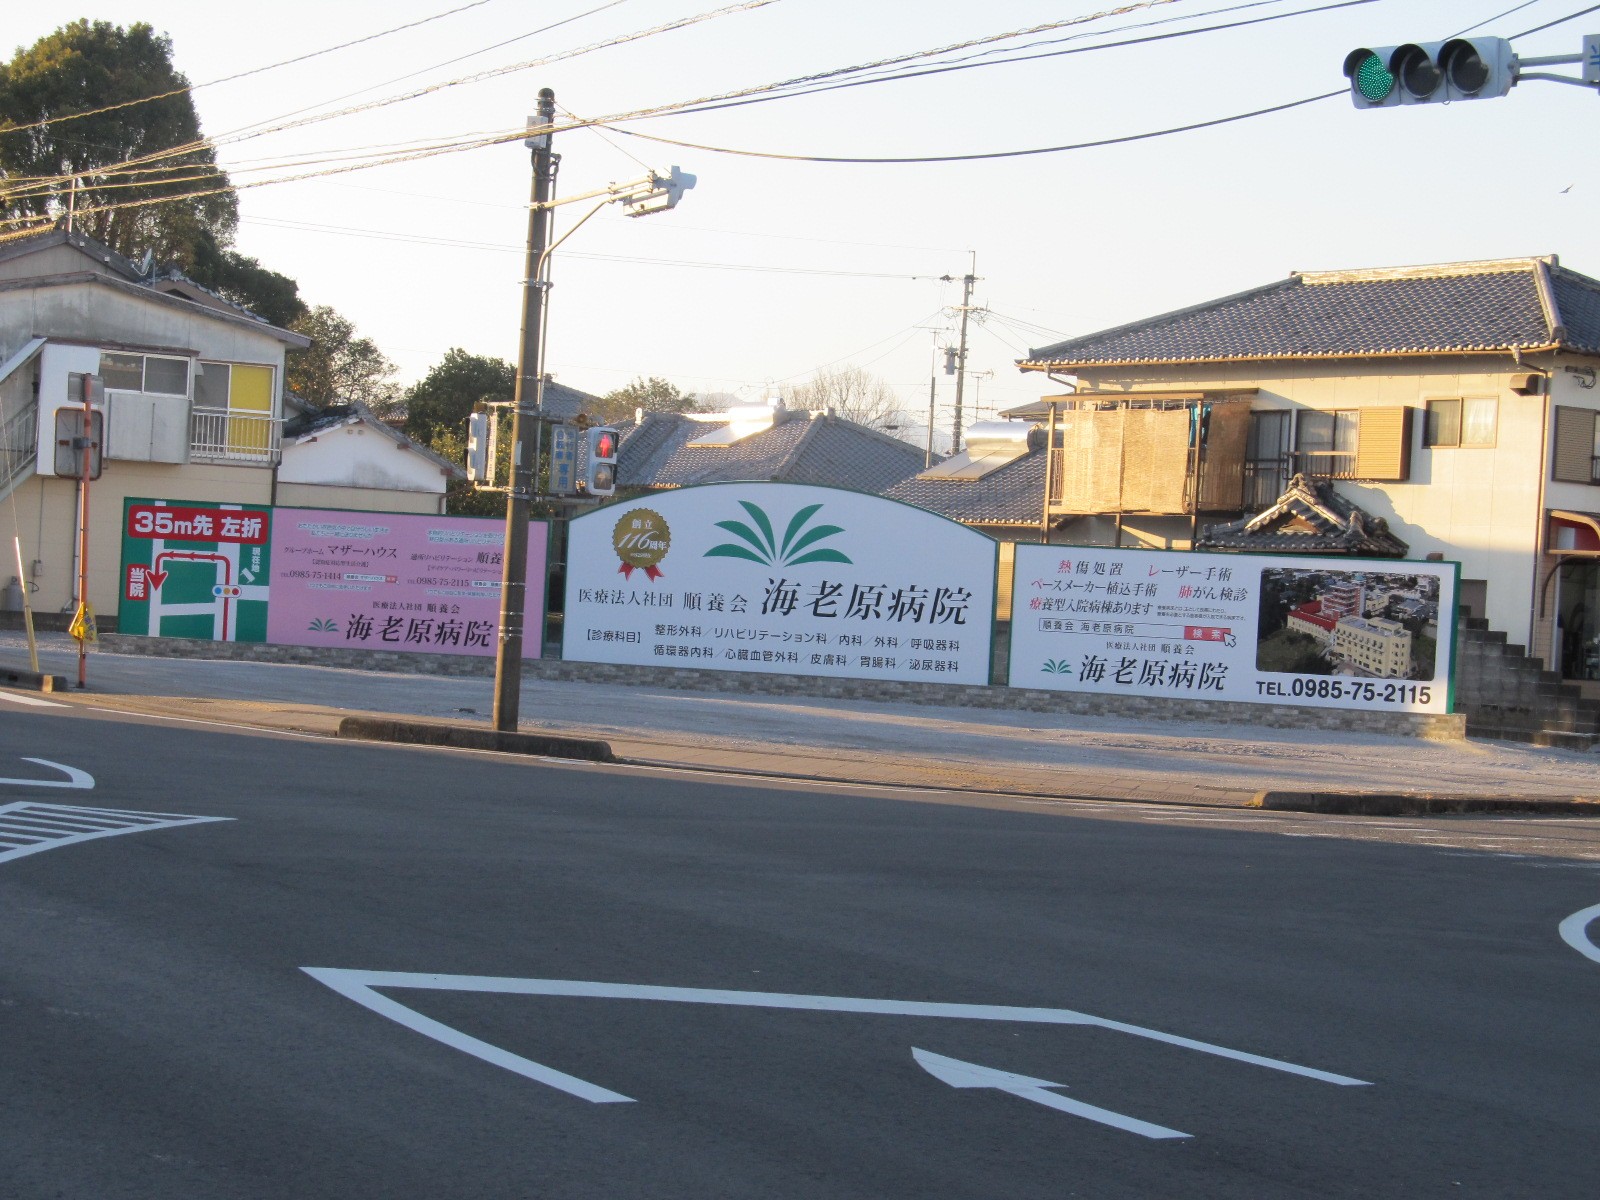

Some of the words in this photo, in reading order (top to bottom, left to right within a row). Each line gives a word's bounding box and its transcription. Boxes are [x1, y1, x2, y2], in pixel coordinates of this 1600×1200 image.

[135, 512, 212, 535] 35m先
[220, 516, 262, 538] 左折
[328, 545, 397, 558] マザーハウス
[476, 551, 505, 565] 順養
[130, 567, 145, 598] 当院
[1058, 560, 1123, 576] 熱傷処置
[1148, 564, 1233, 582] レーザー手術
[578, 588, 674, 607] 医療法人社団
[683, 592, 748, 613] 順養会
[761, 577, 973, 625] 海老原病院
[1031, 578, 1158, 597] ペースメーカー植込手術
[1178, 584, 1249, 602] 肺がん検診
[372, 601, 422, 611] 医療法人社団
[426, 604, 460, 614] 順養会
[1029, 597, 1153, 616] 療養型入院病棟あります
[346, 613, 494, 647] 海老原病院
[1042, 619, 1074, 631] 順養会
[1080, 622, 1135, 635] 海老原病院
[1106, 641, 1156, 652] 医療法人社団
[1160, 644, 1195, 656] 順養会
[1079, 654, 1229, 691] 海老原病院
